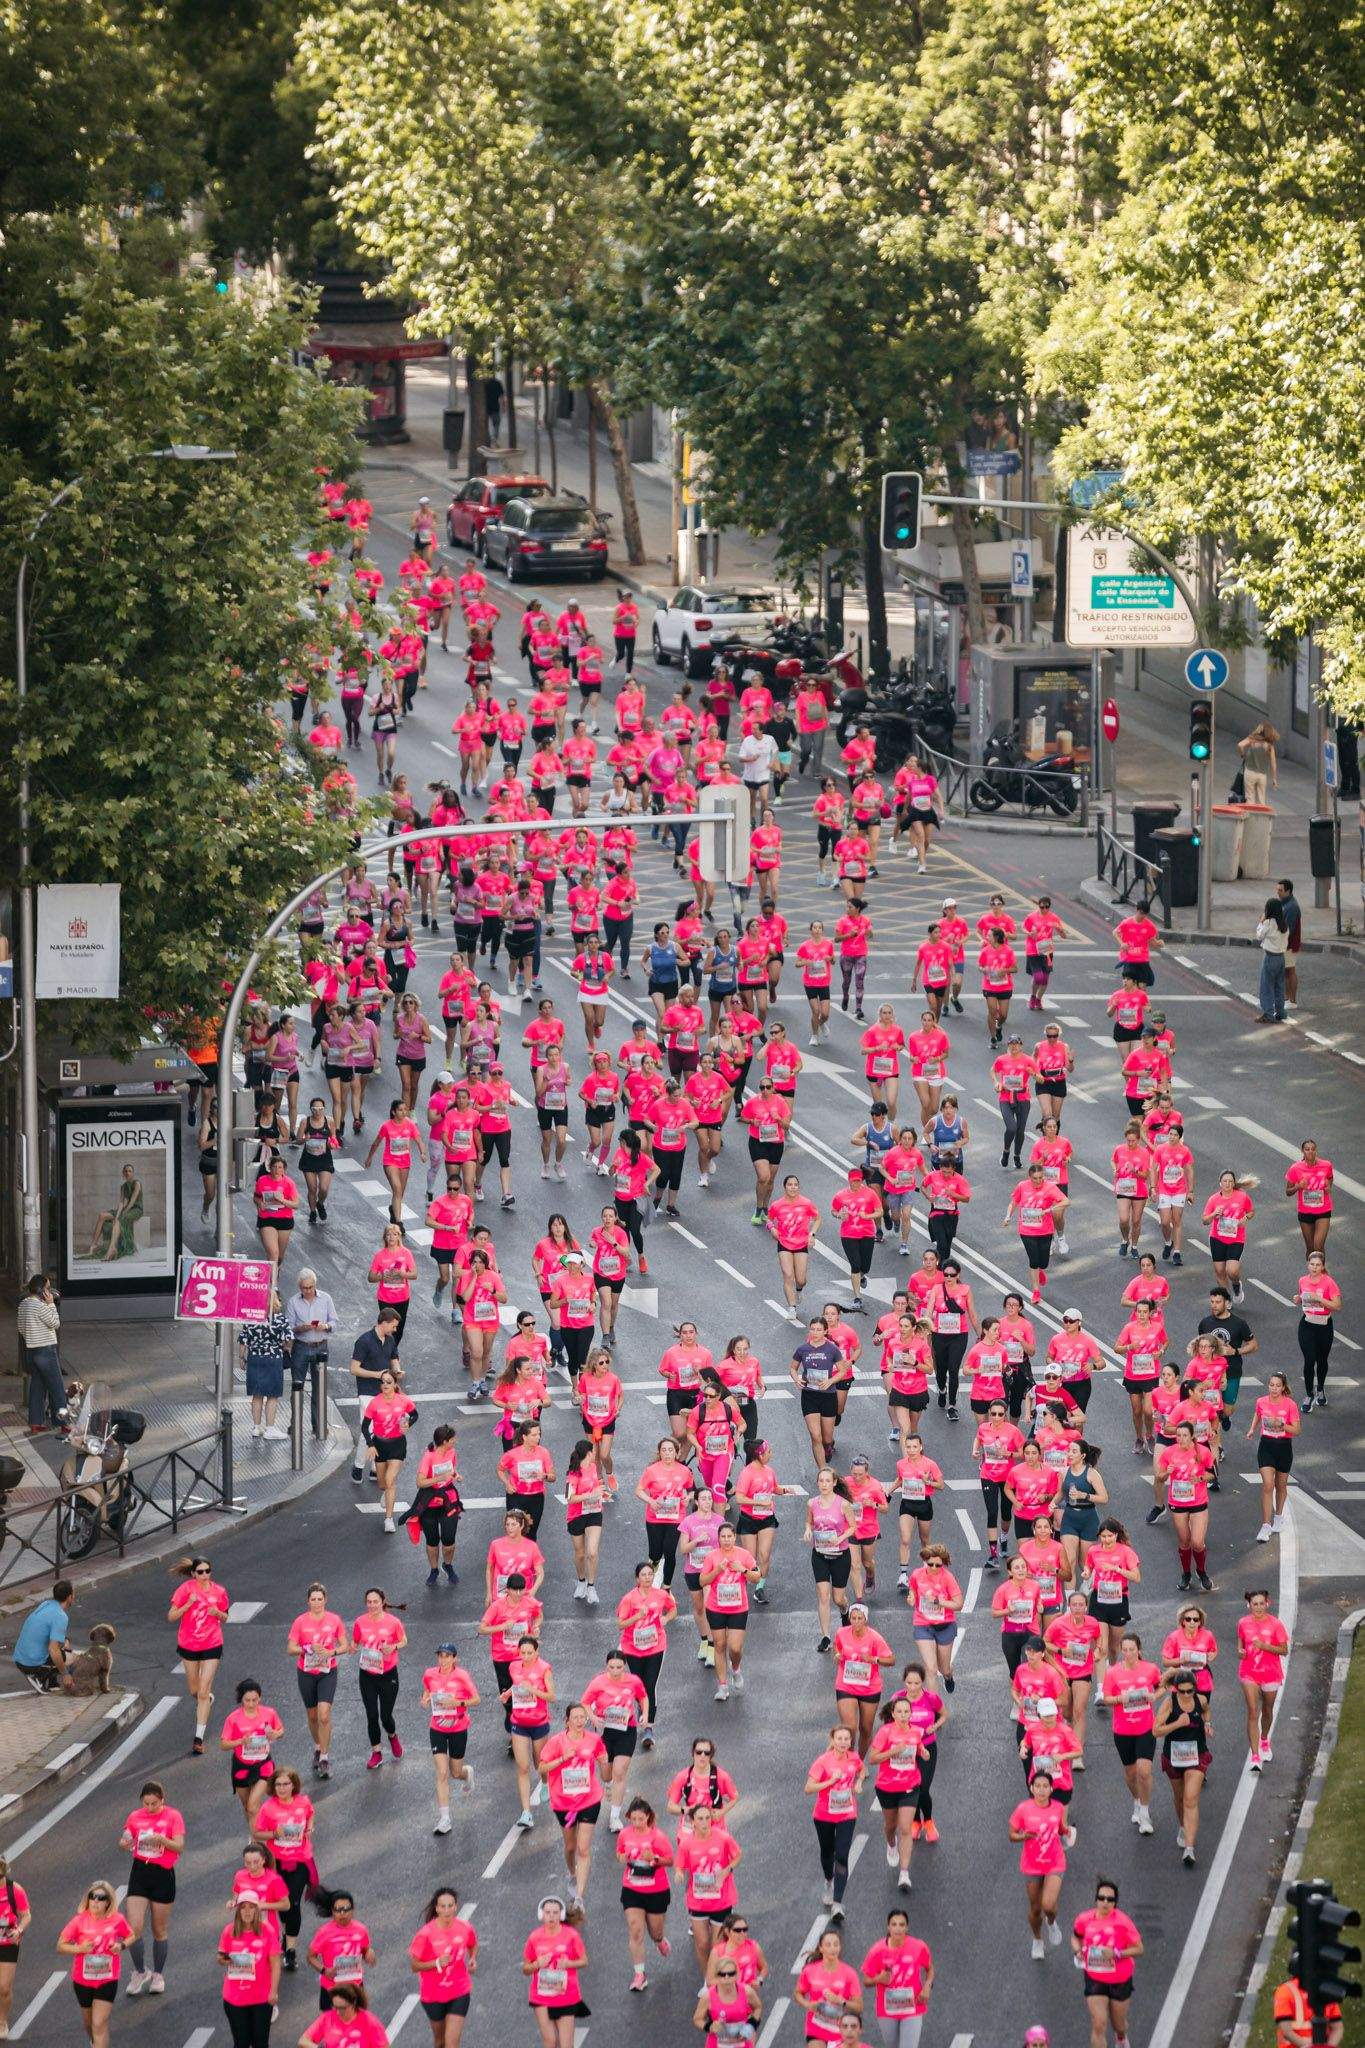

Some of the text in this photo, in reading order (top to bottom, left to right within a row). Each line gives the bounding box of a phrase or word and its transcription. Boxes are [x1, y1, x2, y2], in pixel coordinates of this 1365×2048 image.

[1096, 588, 1118, 596] calle
[1158, 588, 1170, 596] de
[1121, 613, 1188, 621] RESTRINGIDO
[66, 986, 97, 994] MADRID
[71, 1129, 166, 1148] SIMORRA
[191, 1261, 226, 1281] Km
[194, 1282, 217, 1315] 3
